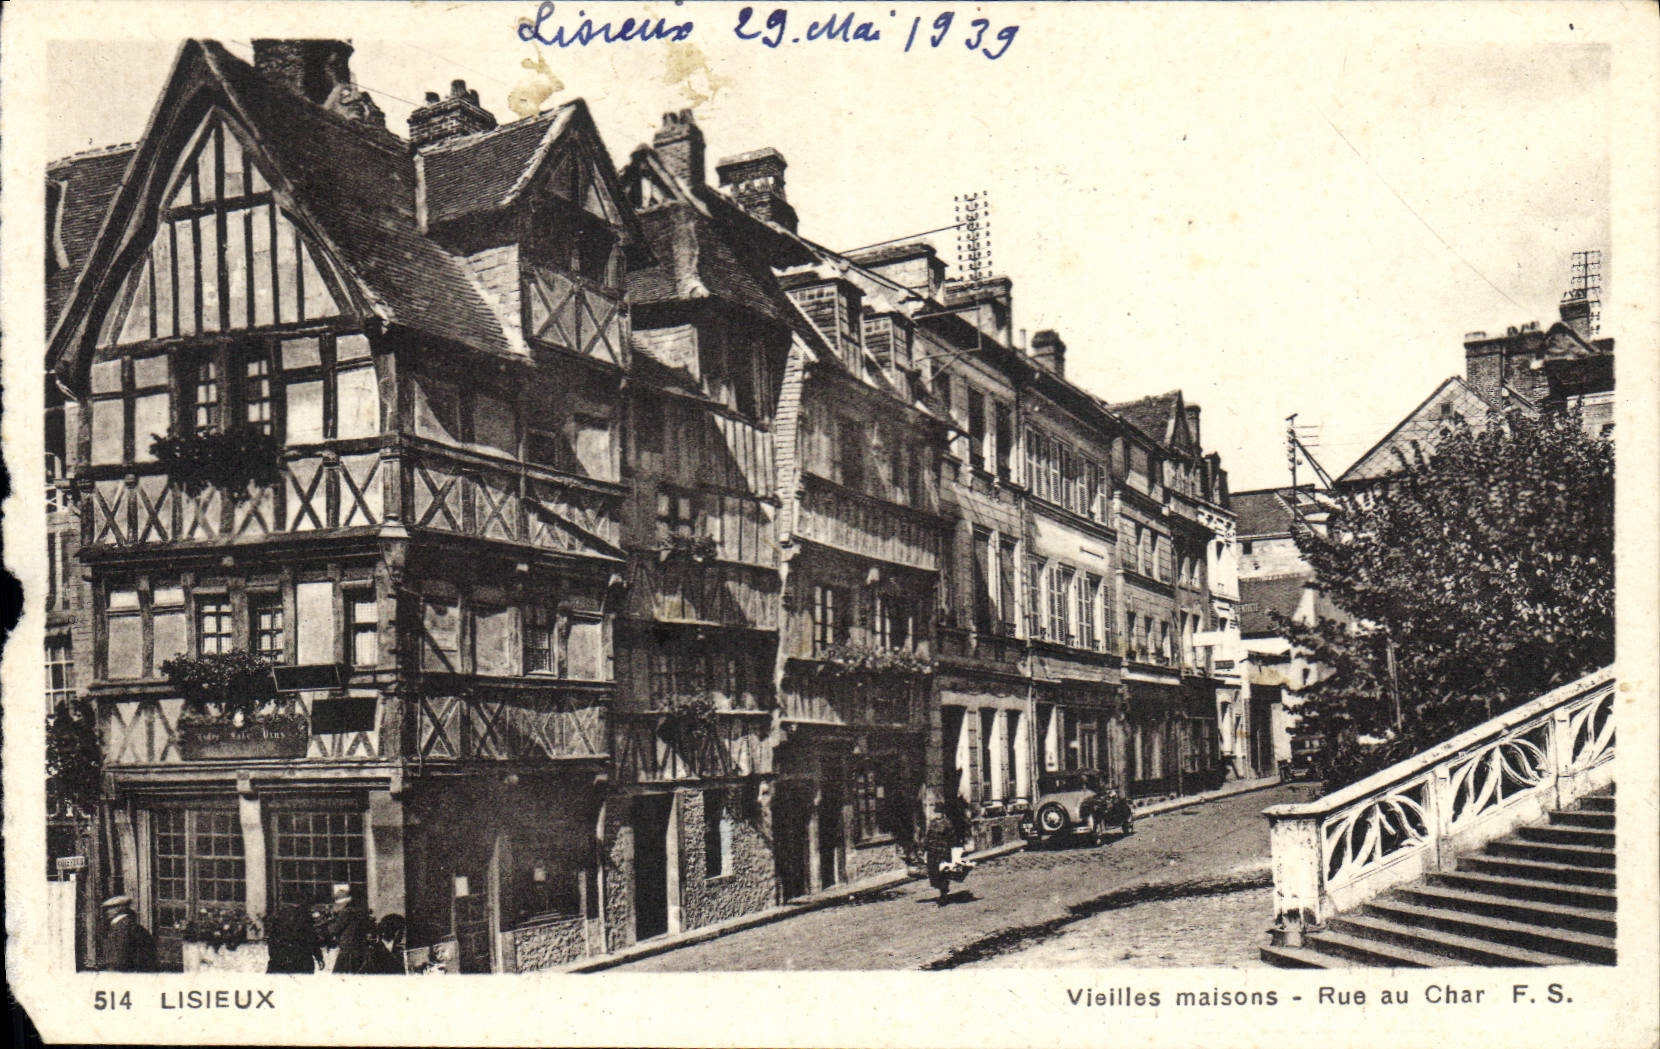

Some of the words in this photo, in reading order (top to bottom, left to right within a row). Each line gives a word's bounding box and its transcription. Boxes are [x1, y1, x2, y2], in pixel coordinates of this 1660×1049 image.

[518, 1, 694, 48] Lisieux
[806, 9, 896, 43] Mai
[904, 9, 1020, 60] 1939
